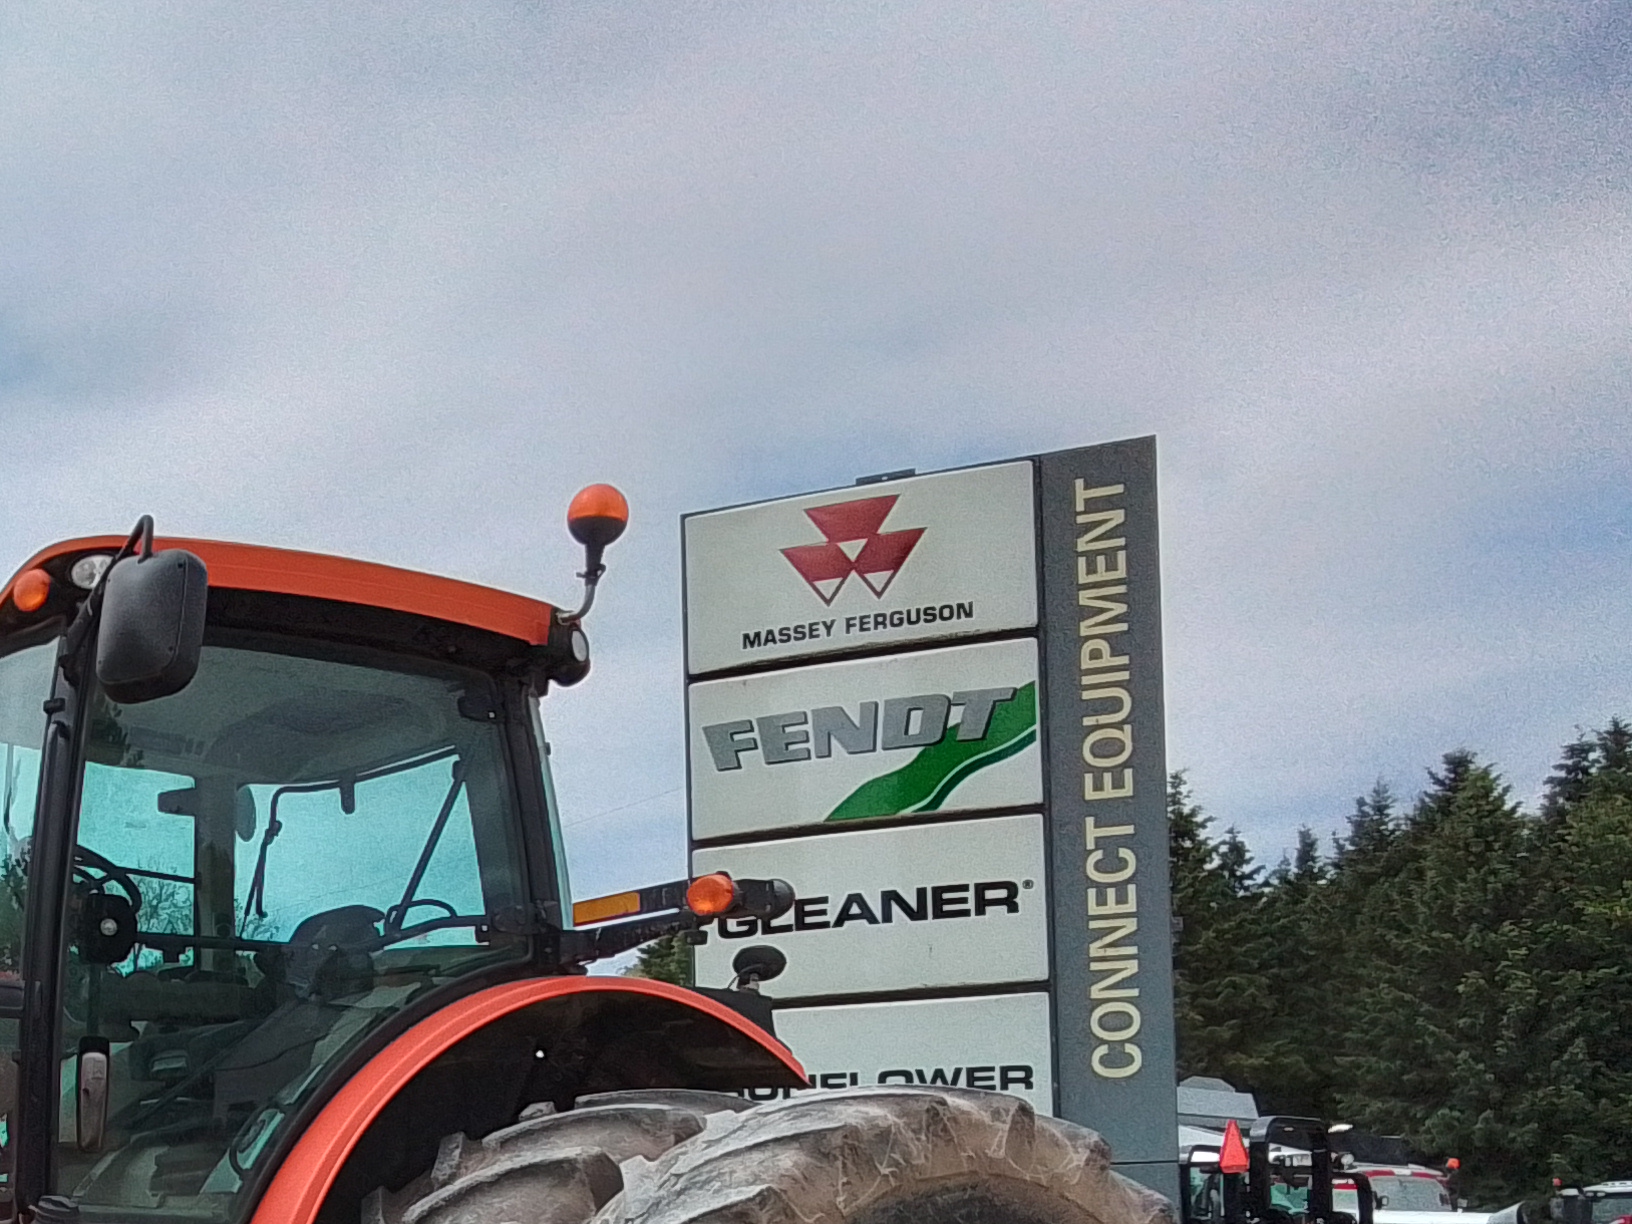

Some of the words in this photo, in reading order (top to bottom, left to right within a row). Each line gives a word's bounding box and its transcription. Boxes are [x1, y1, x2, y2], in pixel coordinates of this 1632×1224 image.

[742, 619, 836, 650] MASSEY
[844, 601, 974, 634] FERGUSON
[1074, 477, 1134, 800] EQUIPMENT
[702, 686, 1016, 772] FENDT
[1085, 816, 1143, 1079] CONNECT
